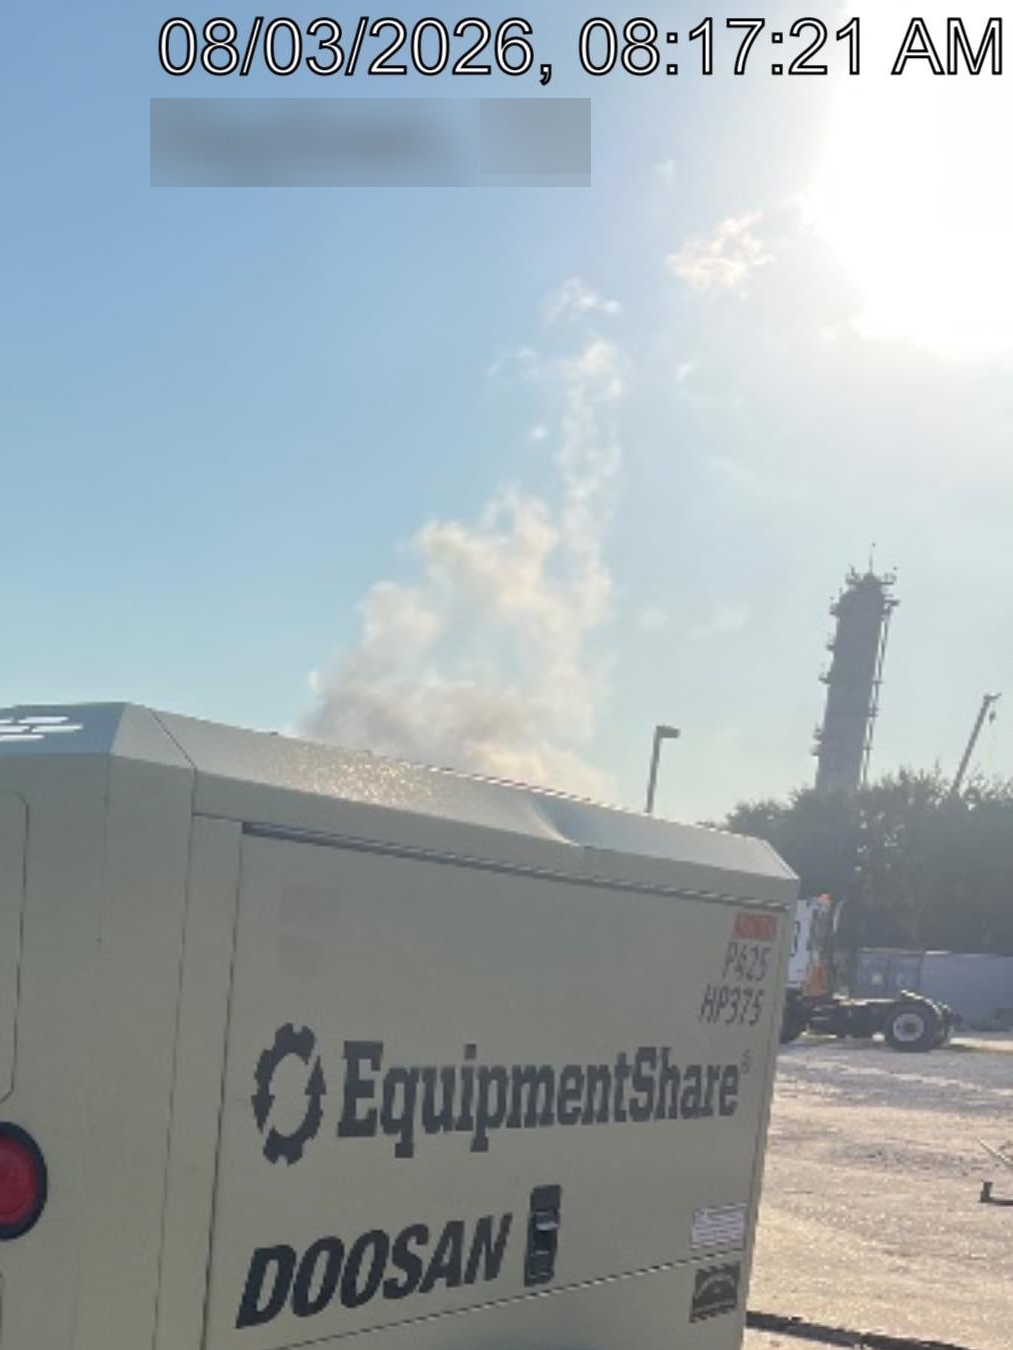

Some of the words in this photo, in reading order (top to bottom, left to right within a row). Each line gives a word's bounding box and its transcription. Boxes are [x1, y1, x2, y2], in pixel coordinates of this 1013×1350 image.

[723, 941, 769, 981] P425
[698, 983, 764, 1026] HP375
[337, 1041, 739, 1158] EquipmentShare
[235, 1213, 513, 1328] DOOSAN
